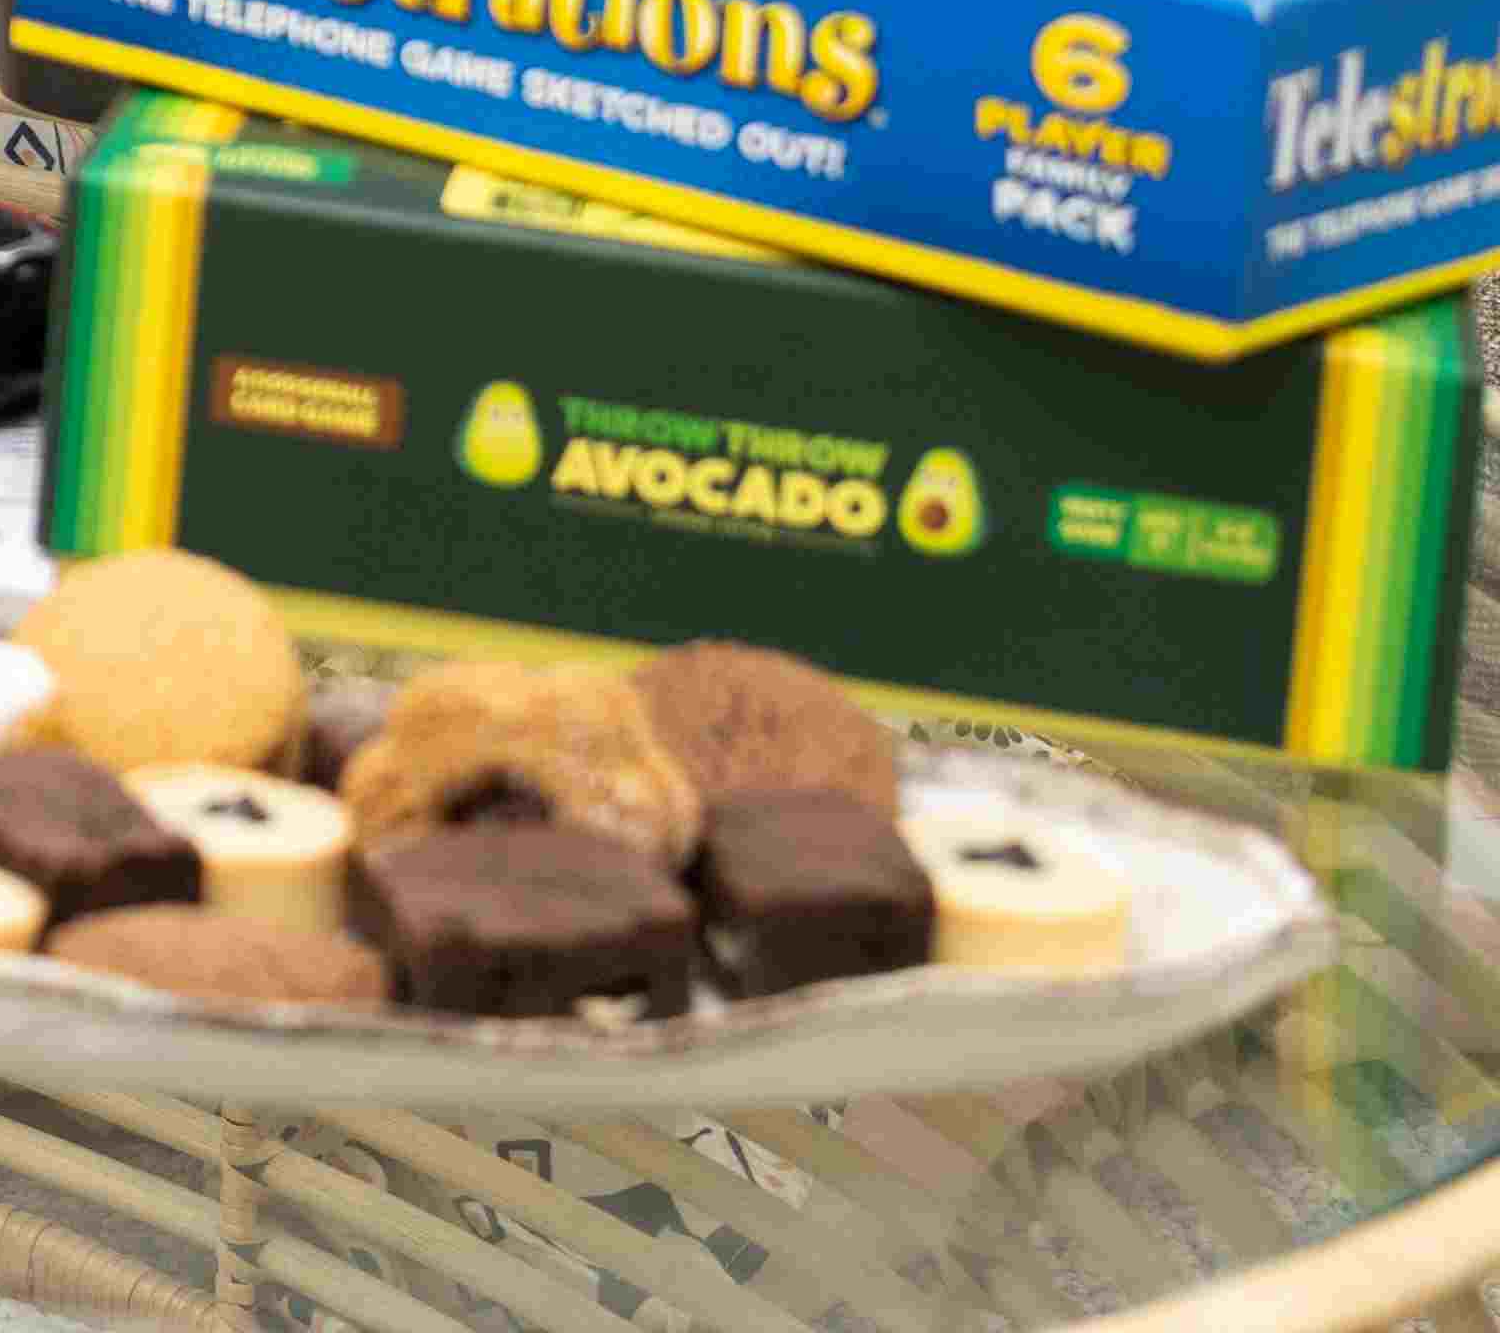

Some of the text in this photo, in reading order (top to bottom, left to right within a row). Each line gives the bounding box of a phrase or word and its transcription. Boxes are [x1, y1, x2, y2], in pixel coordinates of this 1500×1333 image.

[1031, 11, 1134, 114] 6
[400, 38, 515, 100] GAME
[521, 66, 732, 151] SKETCHED
[737, 120, 848, 181] OUT!
[974, 94, 1172, 182] PLAYER
[991, 177, 1139, 257] PACK
[1005, 145, 1135, 205] FAMILY
[557, 395, 889, 477] THROW THROW
[551, 435, 887, 539] AVOCADO
